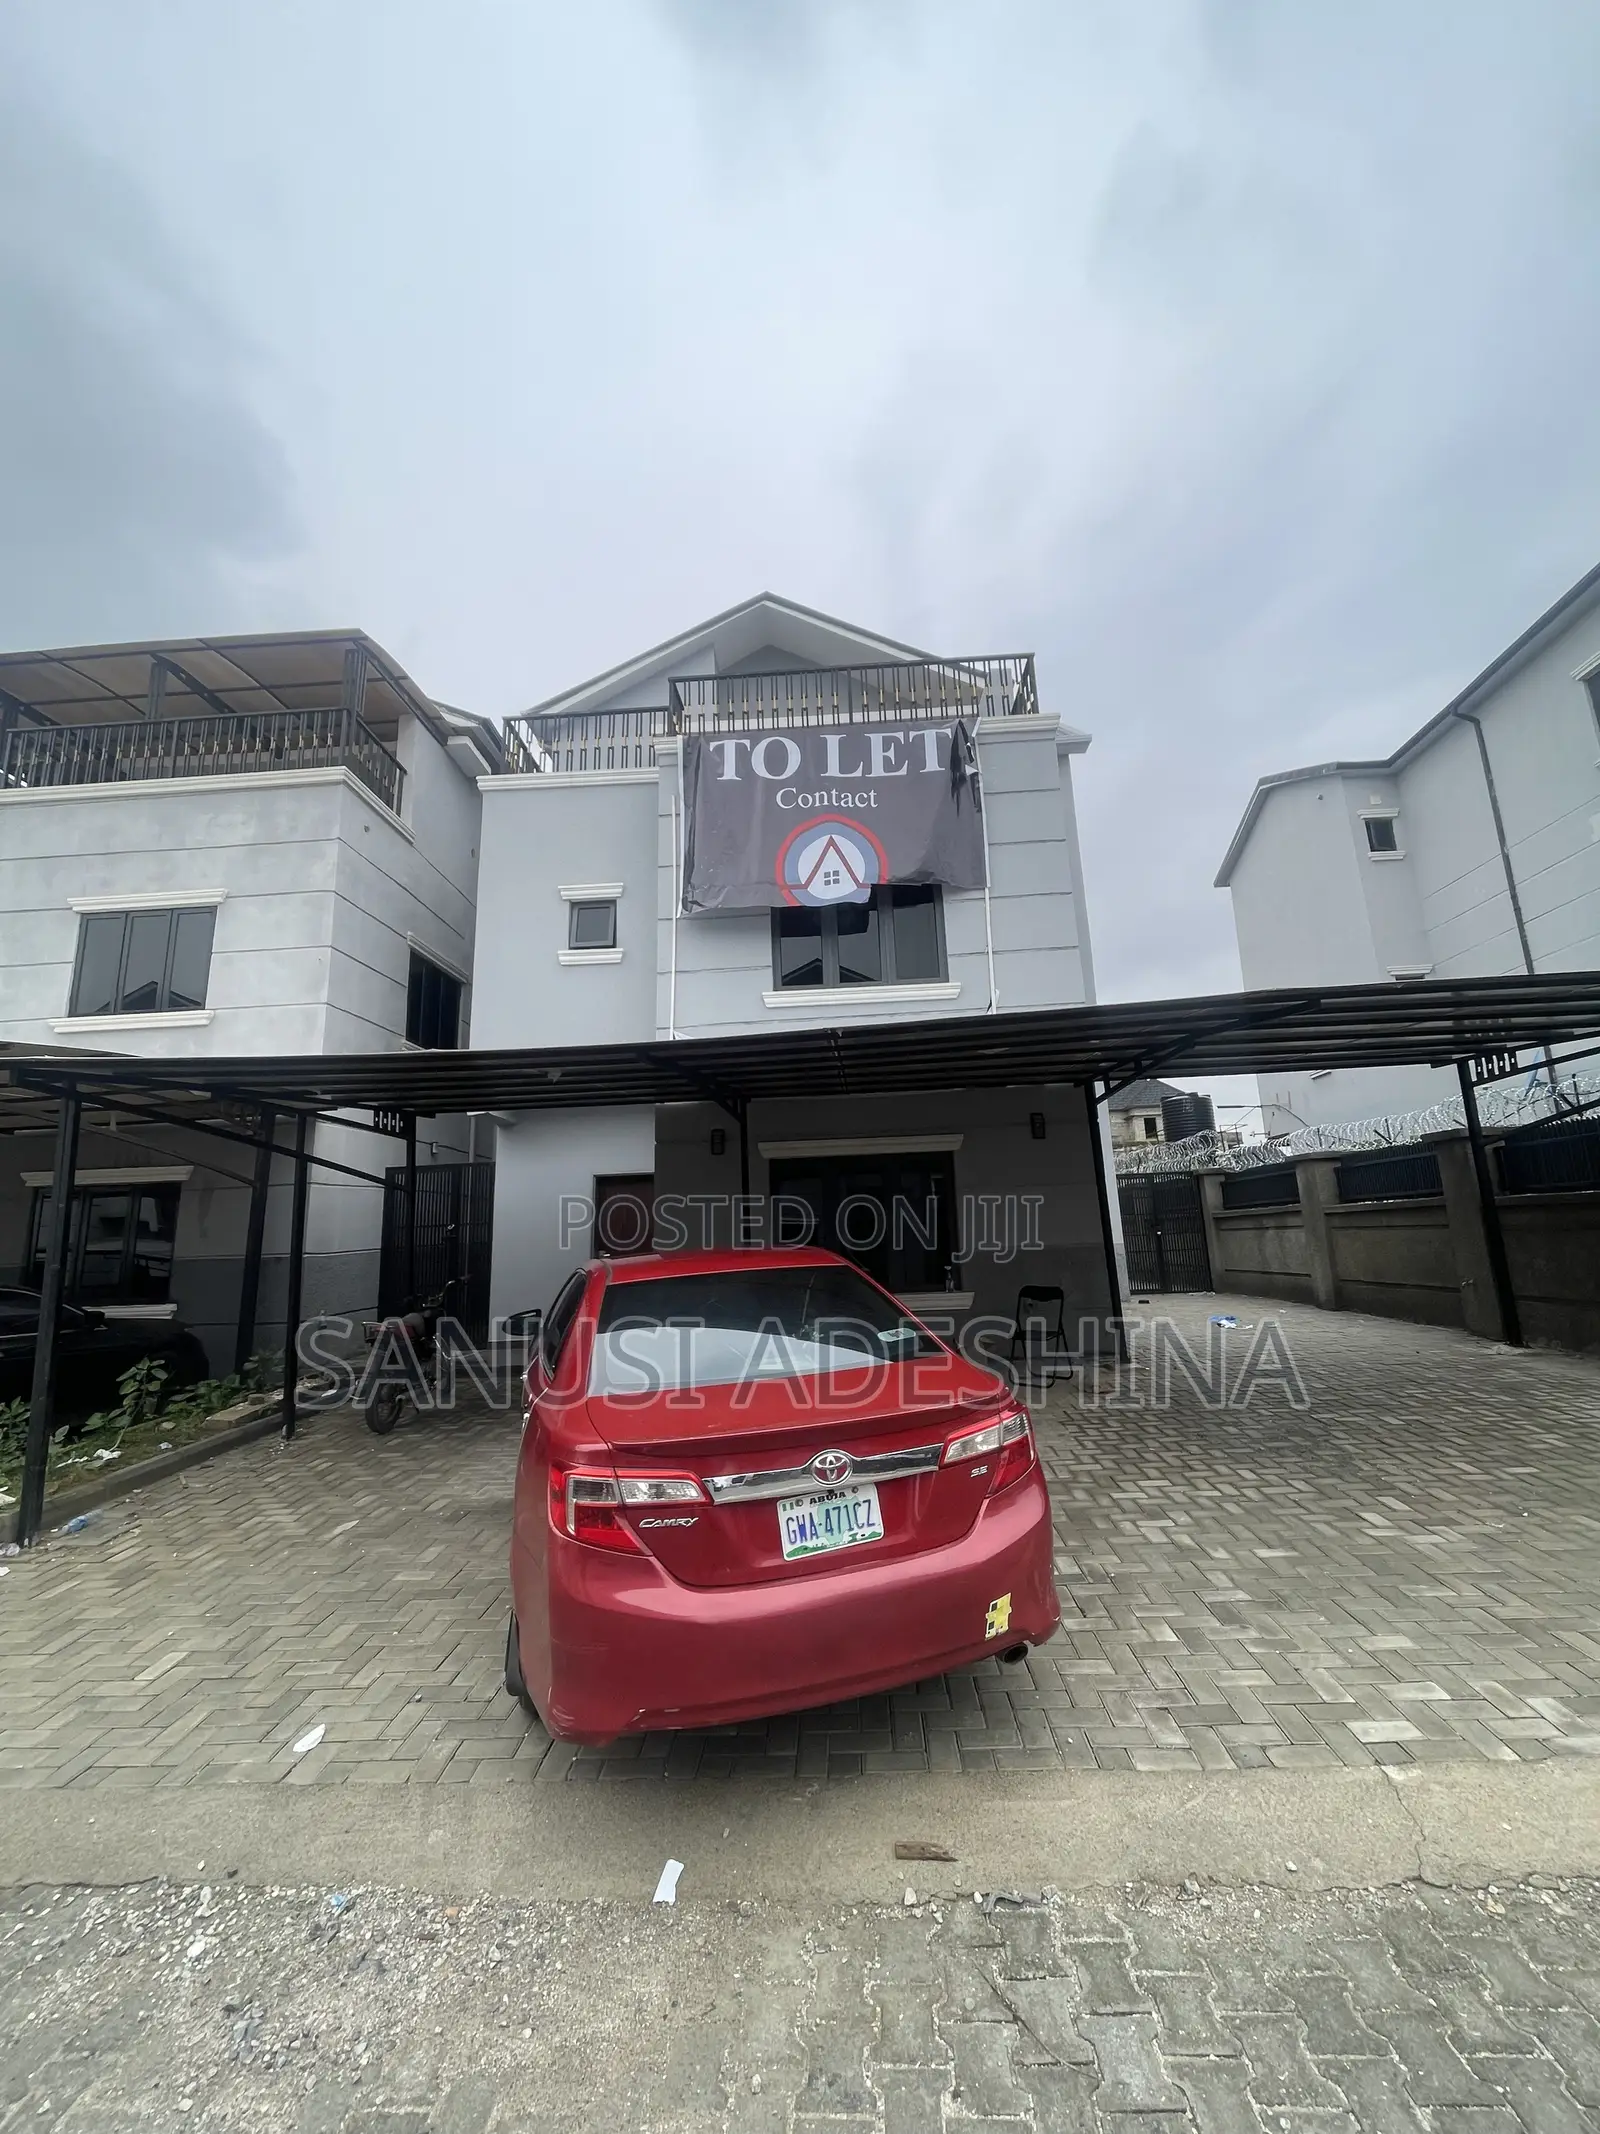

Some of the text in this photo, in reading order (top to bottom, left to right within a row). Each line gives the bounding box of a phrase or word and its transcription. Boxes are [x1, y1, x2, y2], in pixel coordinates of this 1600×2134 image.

[709, 727, 952, 780] TO LET
[775, 787, 879, 809] Contact
[809, 1491, 847, 1505] ABUJA
[639, 1517, 699, 1528] CAMRY
